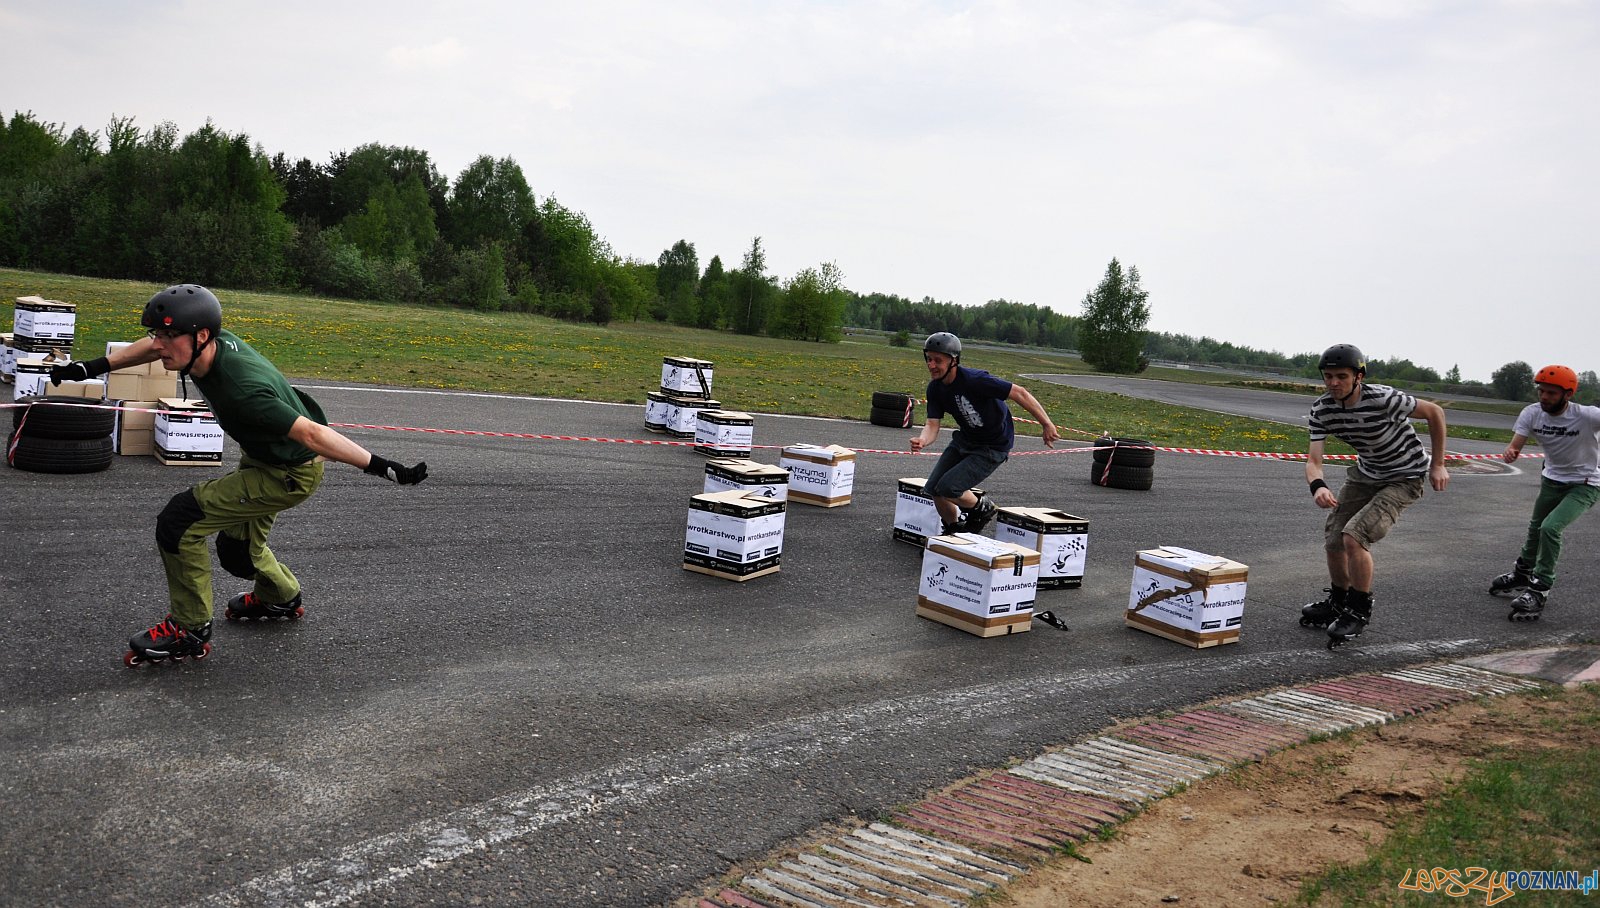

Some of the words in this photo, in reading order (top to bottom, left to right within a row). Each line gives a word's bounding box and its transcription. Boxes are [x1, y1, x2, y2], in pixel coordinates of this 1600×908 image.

[166, 431, 223, 441] wrotkarstwo.pl
[793, 473, 829, 486] tempo.pl
[899, 493, 915, 502] URBAN
[914, 496, 934, 507] SKATING
[687, 523, 746, 543] wrotkarstwo.pl
[747, 528, 782, 542] wrotkarstwo.pl
